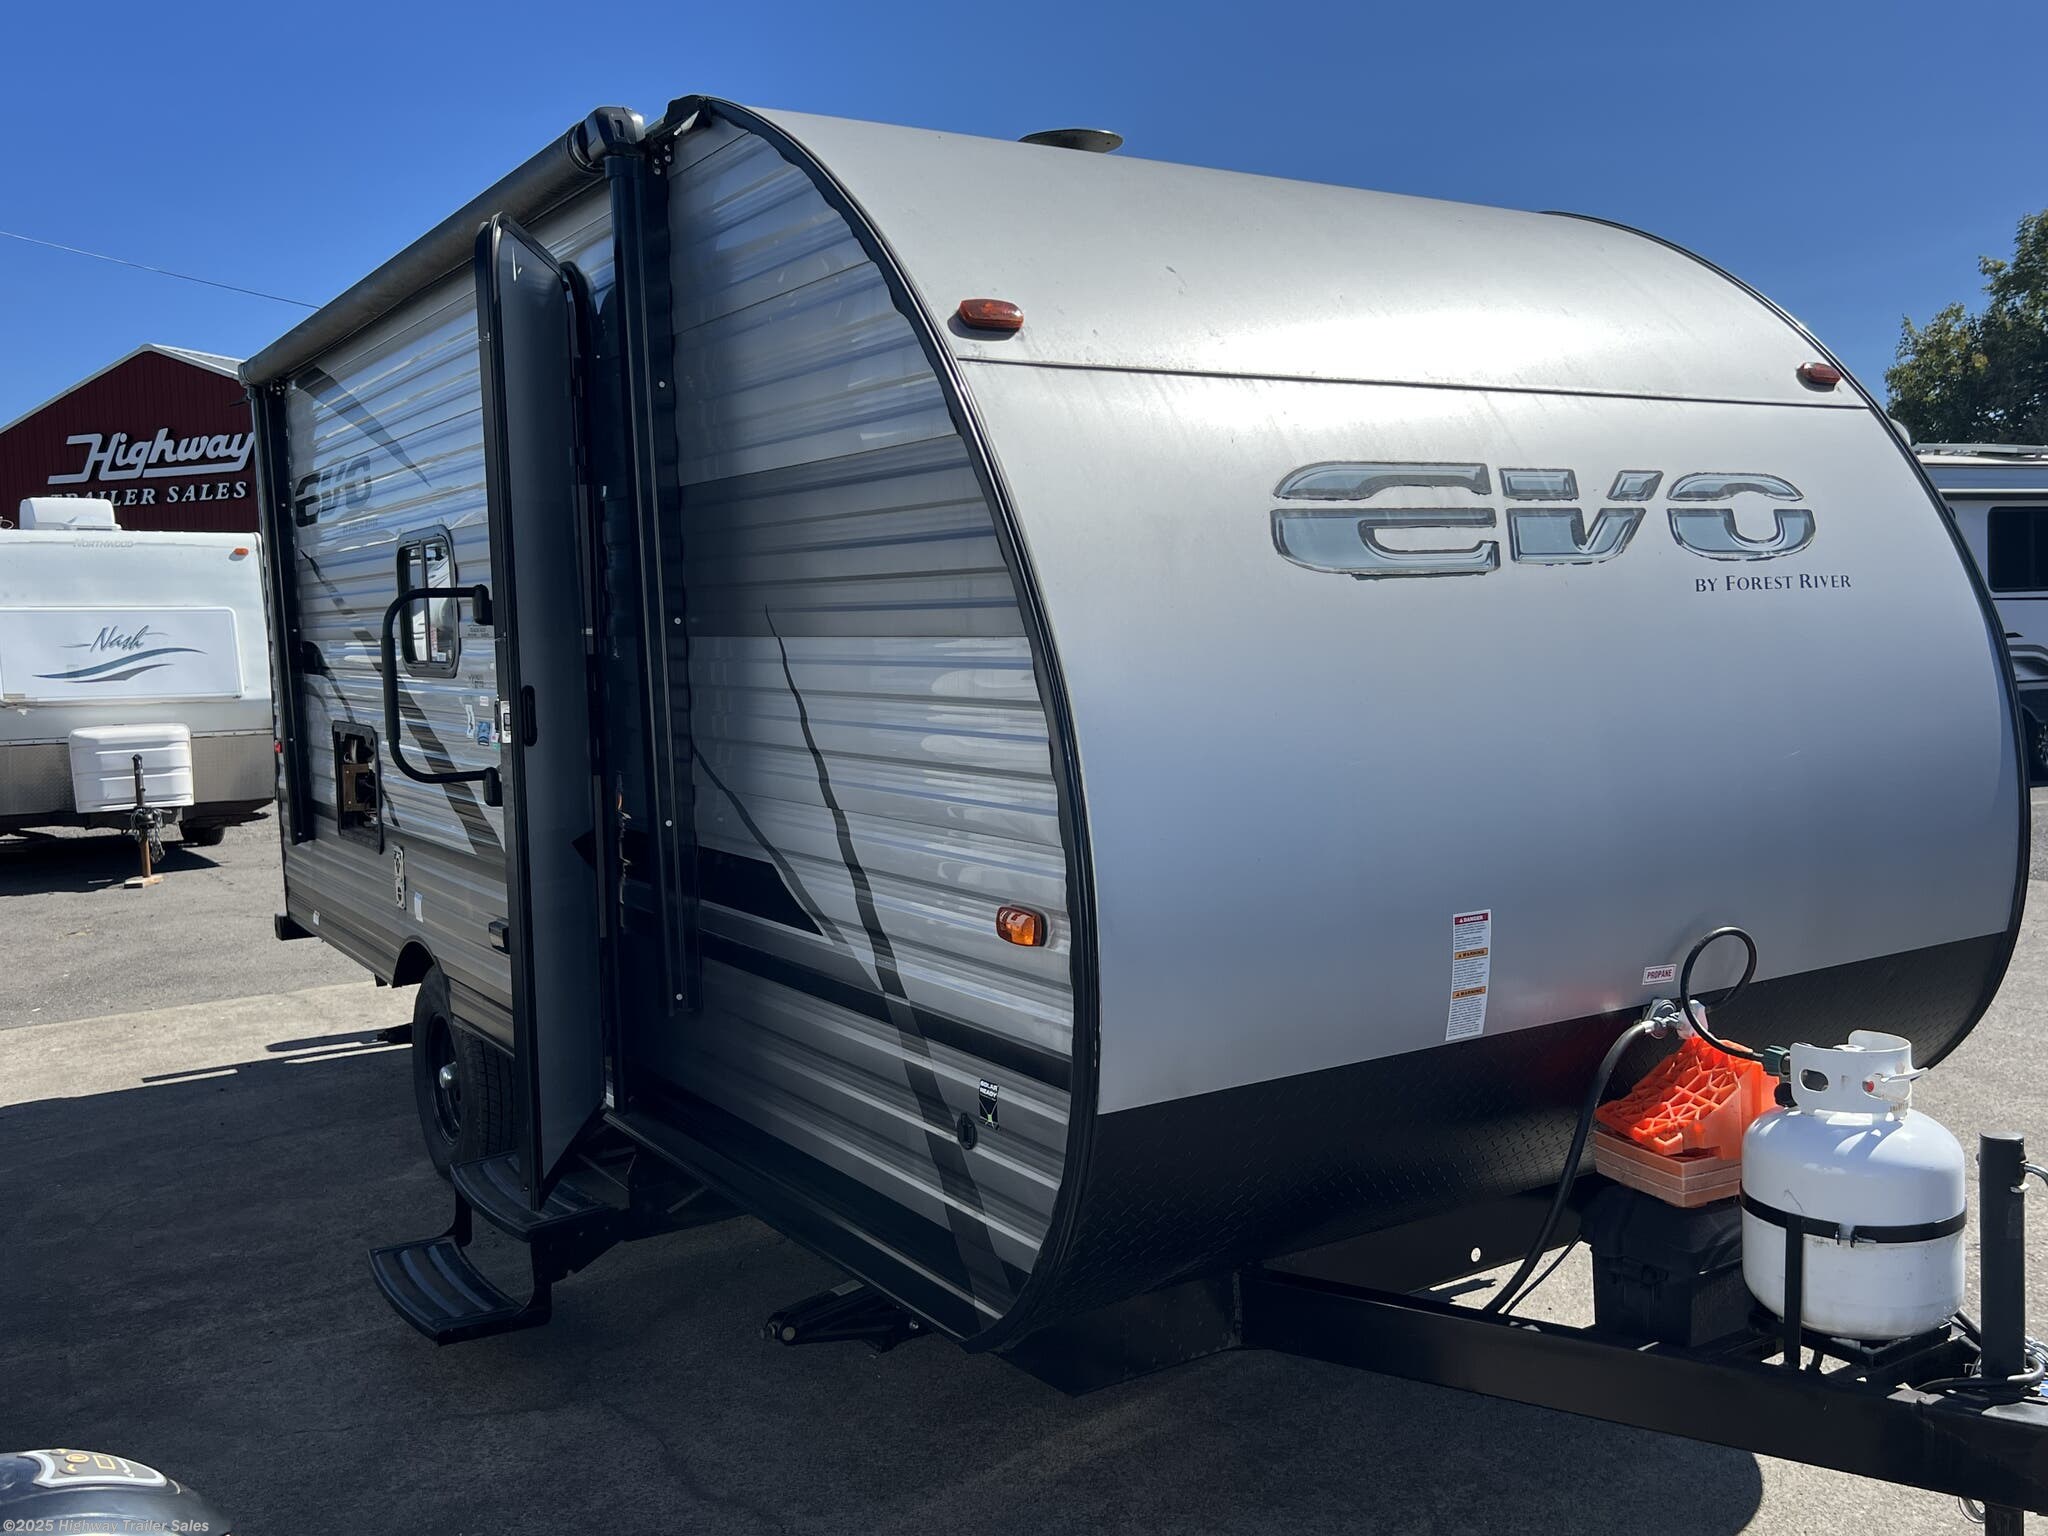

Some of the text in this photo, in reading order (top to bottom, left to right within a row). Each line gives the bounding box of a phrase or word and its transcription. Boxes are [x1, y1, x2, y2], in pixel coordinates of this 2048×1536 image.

[48, 428, 254, 484] Highway
[51, 481, 247, 506] ILER SALES
[1695, 577, 1718, 592] BY
[90, 624, 149, 653] Nash
[1647, 969, 1672, 979] PROPANE
[1460, 988, 1483, 996] WARNING
